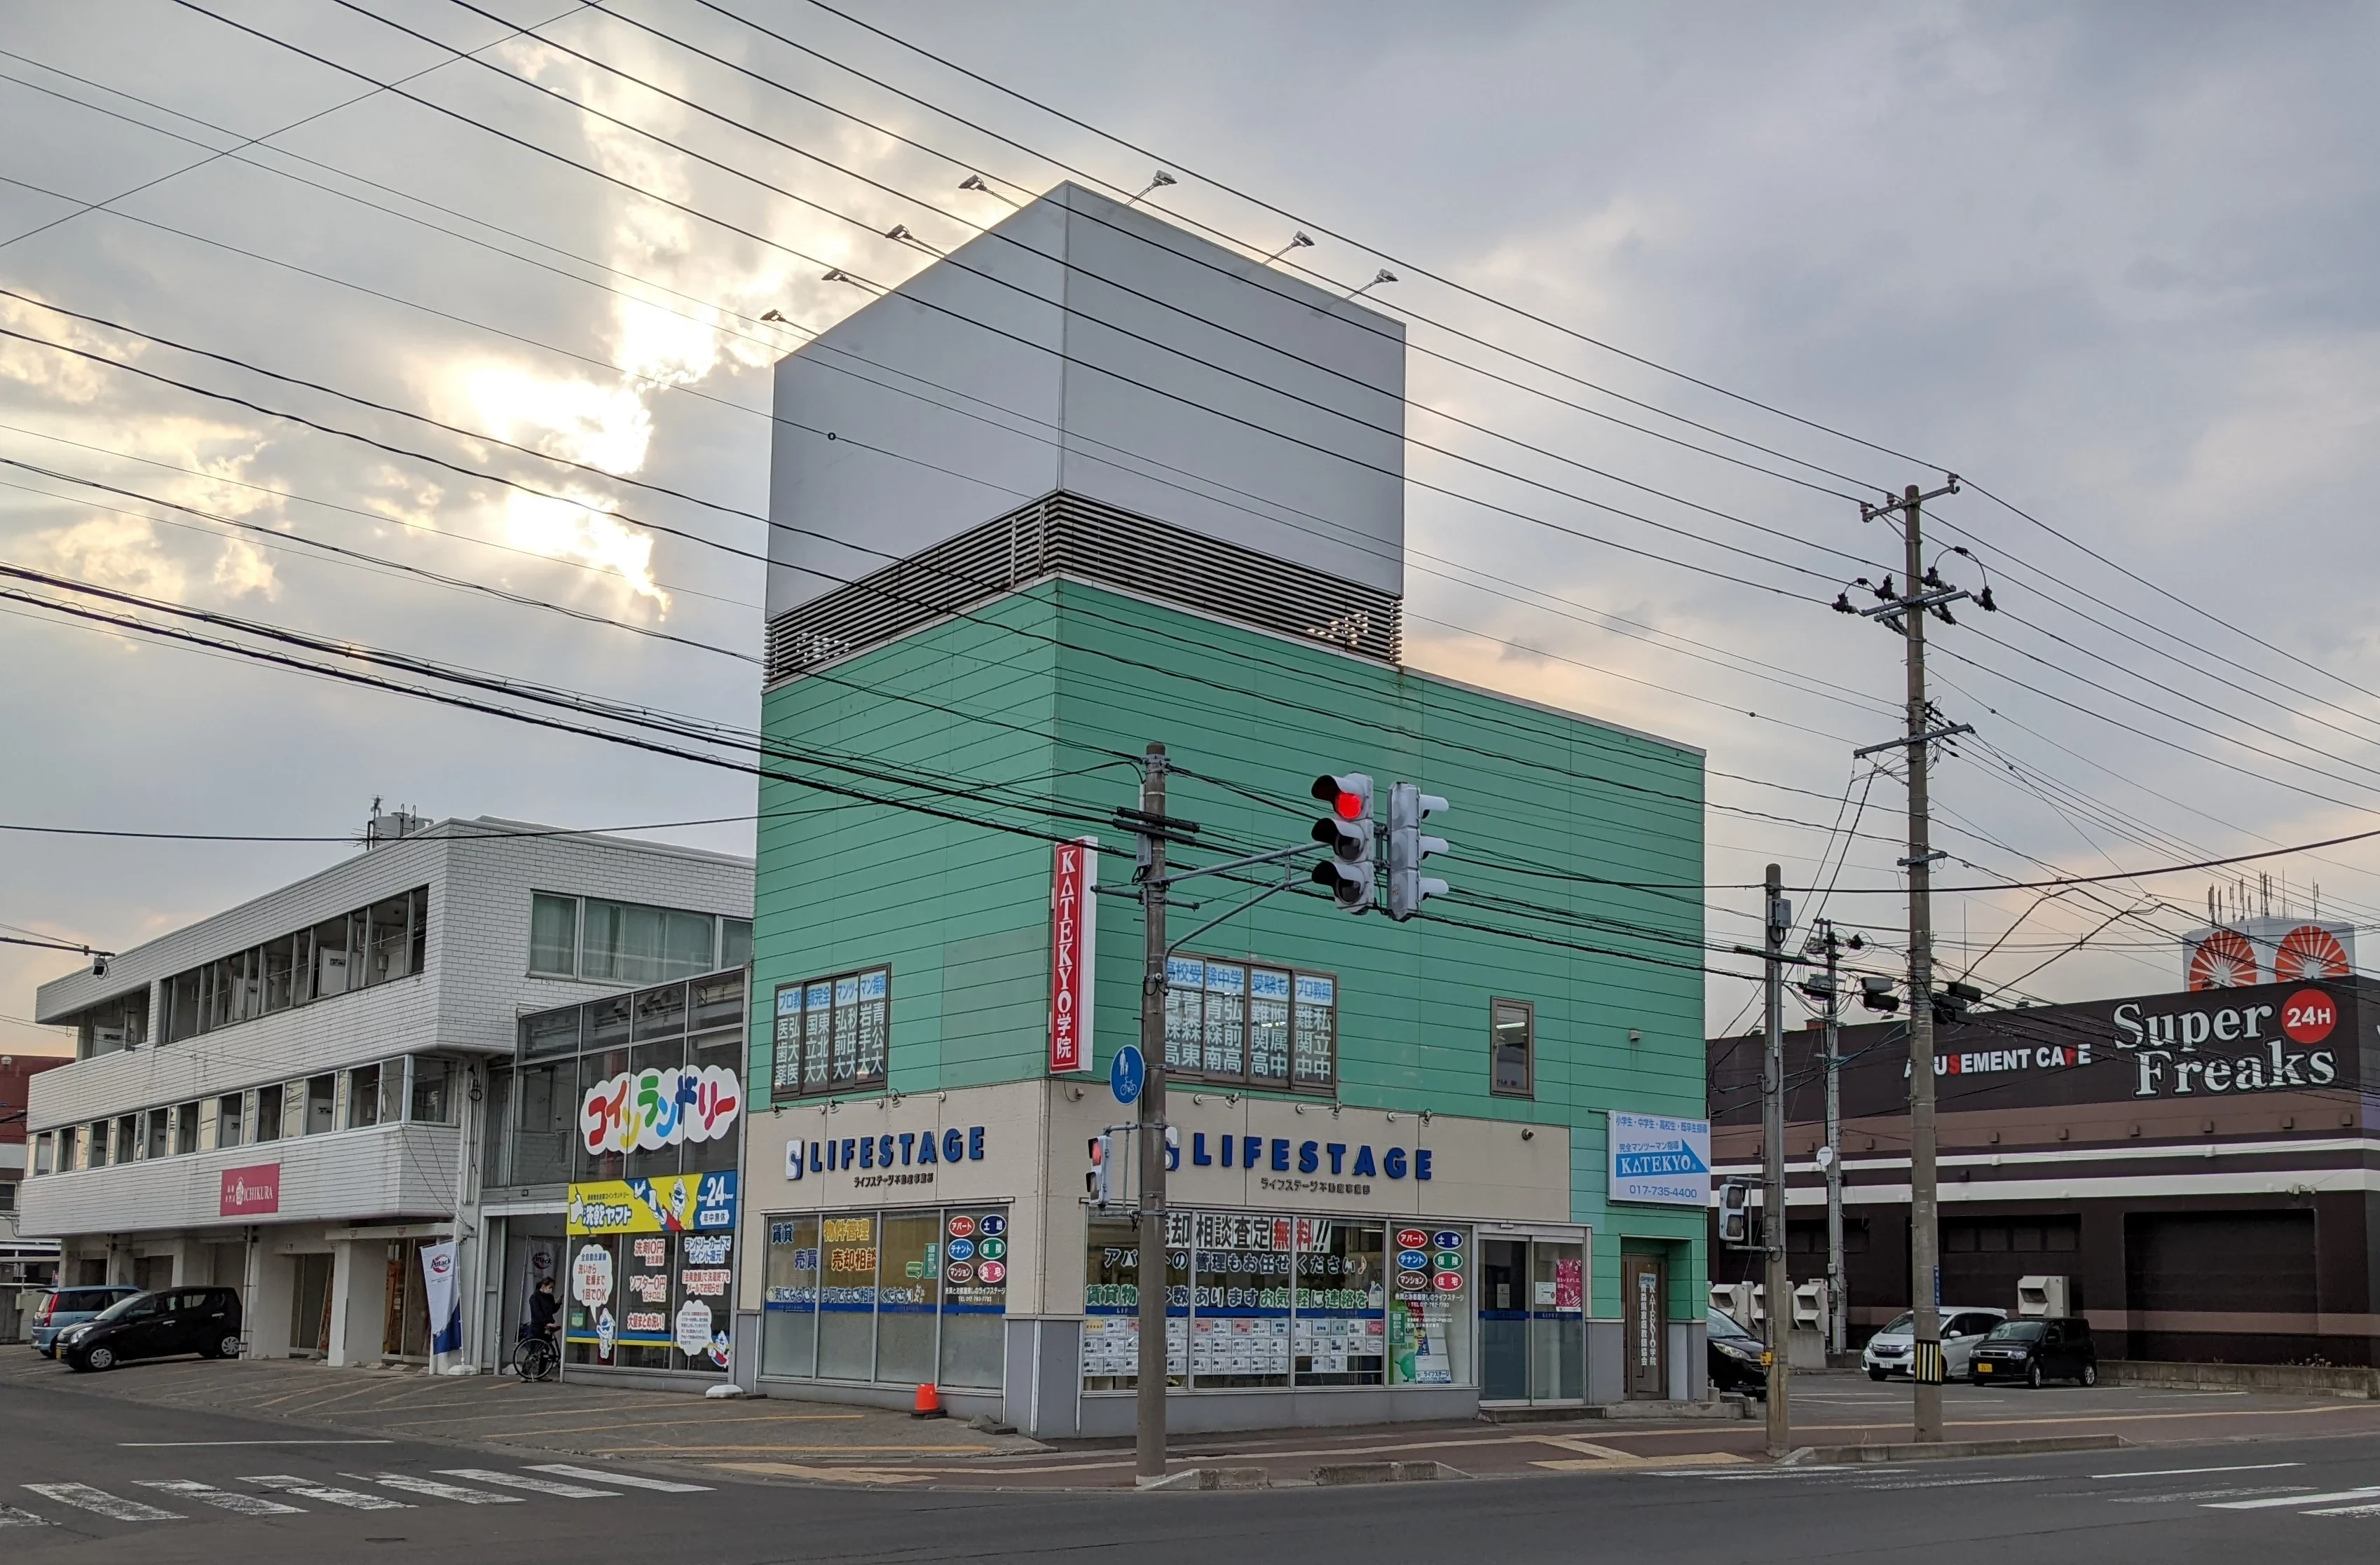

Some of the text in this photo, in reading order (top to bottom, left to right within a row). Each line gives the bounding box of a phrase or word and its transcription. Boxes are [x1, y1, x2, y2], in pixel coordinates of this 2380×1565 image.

[1056, 849, 1076, 1060] KATEKYO学院
[1182, 991, 1201, 1067] 青森東
[2112, 999, 2274, 1052] Super
[2287, 1005, 2332, 1027] 24H
[804, 1014, 818, 1083] 国立大
[816, 1012, 830, 1081] 東北大
[833, 1008, 847, 1080] 弘前大
[858, 1003, 872, 1074] 岩手大
[870, 1002, 884, 1074] 青公大
[1205, 995, 1223, 1071] 青森南
[1224, 997, 1243, 1073] 弘前高
[1251, 1002, 1269, 1076] 難関高
[1270, 1003, 1288, 1077] 附属中
[1295, 1005, 1313, 1079] 難関中
[1313, 1008, 1332, 1081] 私立中
[775, 1018, 789, 1086] 医歯薬
[787, 1016, 800, 1086] 弘大医
[1903, 1042, 2092, 1079] USEMENT CAFE
[2134, 1038, 2336, 1098] Freaks
[588, 1074, 737, 1147] コインランドリー
[809, 1126, 985, 1173] LIFESTAGE
[1193, 1132, 1432, 1180] LIFESTAGE
[1619, 1140, 1679, 1153] 完全マンツーマン指導
[1621, 1154, 1690, 1174] KATEKYO
[706, 1175, 725, 1207] 24
[1629, 1184, 1697, 1198] 017-735-4400
[703, 1213, 726, 1223] 年中無休
[772, 1222, 793, 1244] 賃貸
[823, 1219, 870, 1242] 物件管理
[635, 1241, 664, 1255] 洗剤0円
[685, 1238, 730, 1250] ランドリーカードで
[794, 1248, 818, 1271] 売買
[832, 1248, 876, 1272] 売却相談
[950, 1245, 971, 1254] テナント
[1401, 1255, 1424, 1264] テナント
[577, 1264, 597, 1275] 洗いから
[950, 1268, 971, 1277] マンション
[1104, 1248, 1355, 1275] アパの管理もお任せください
[582, 1288, 607, 1301] 1回でOK
[586, 1275, 606, 1285] 乾燥まで
[630, 1276, 666, 1290] ソフター0円
[1086, 1284, 1368, 1308] 賃貸物数ありますお気軽に連絡を
[1400, 1276, 1424, 1285] マンション
